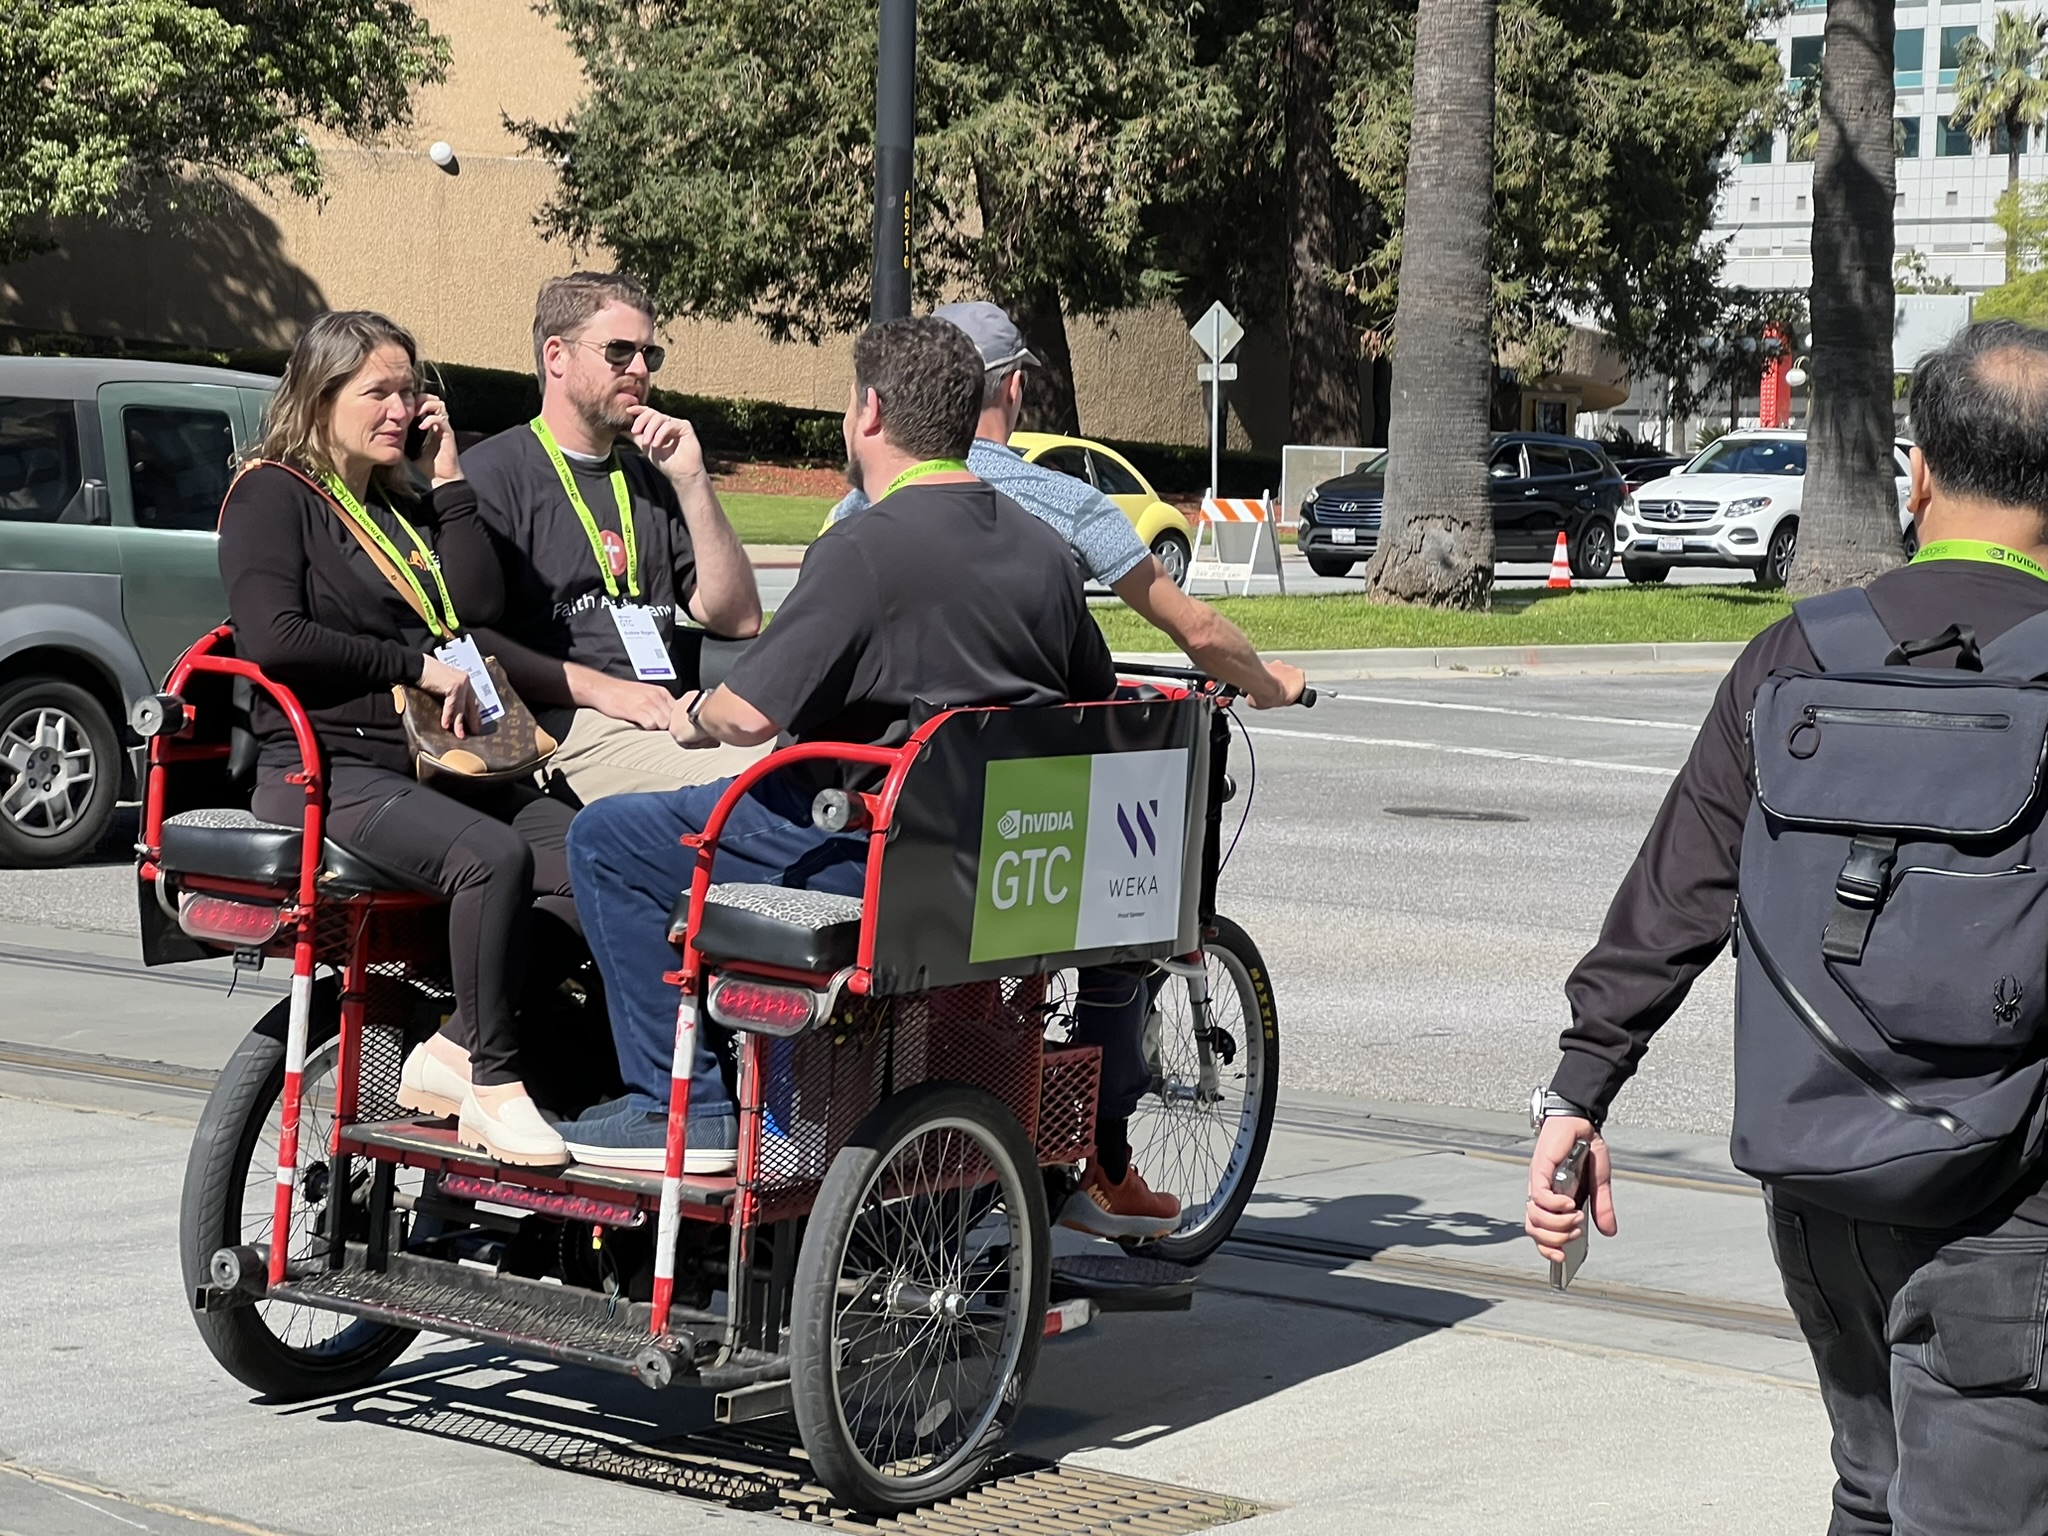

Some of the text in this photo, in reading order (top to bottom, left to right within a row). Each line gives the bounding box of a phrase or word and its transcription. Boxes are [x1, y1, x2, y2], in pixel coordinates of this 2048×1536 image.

[552, 593, 596, 621] Faith
[1022, 811, 1074, 834] NVIDIA
[991, 845, 1072, 910] GTC
[1109, 875, 1158, 898] WEKA
[1249, 967, 1274, 1039] MAXXIS
